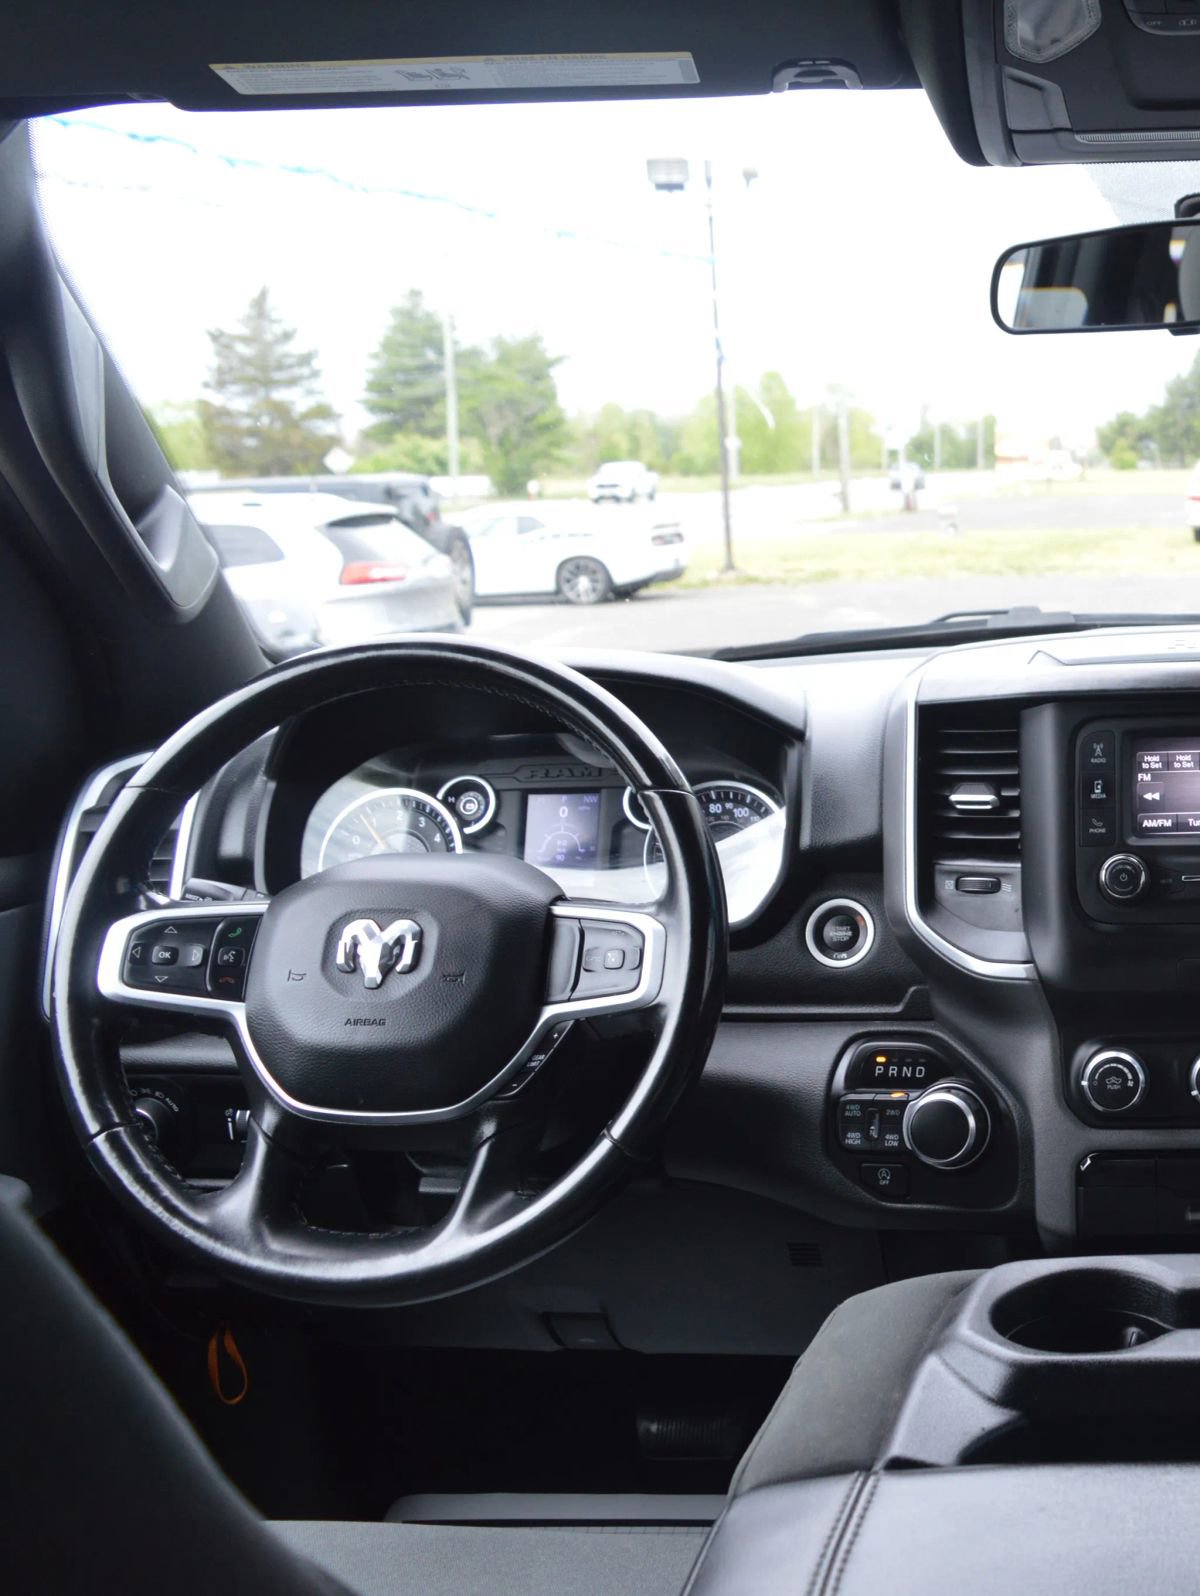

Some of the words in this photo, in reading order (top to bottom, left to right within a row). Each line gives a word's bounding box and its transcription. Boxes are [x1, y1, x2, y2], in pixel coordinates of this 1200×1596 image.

[1138, 774, 1151, 782] FM
[559, 806, 568, 818] 0
[709, 804, 722, 813] 80
[733, 808, 749, 817] 100
[395, 811, 403, 821] 2
[418, 817, 425, 827] 3
[1142, 819, 1172, 828] AM/FM
[351, 835, 360, 845] 0
[433, 833, 441, 842] 4
[158, 951, 171, 959] OK
[344, 1018, 386, 1026] AIRBAG
[875, 1066, 884, 1077] P
[888, 1066, 898, 1077] R
[902, 1066, 911, 1077] N
[915, 1066, 926, 1078] D
